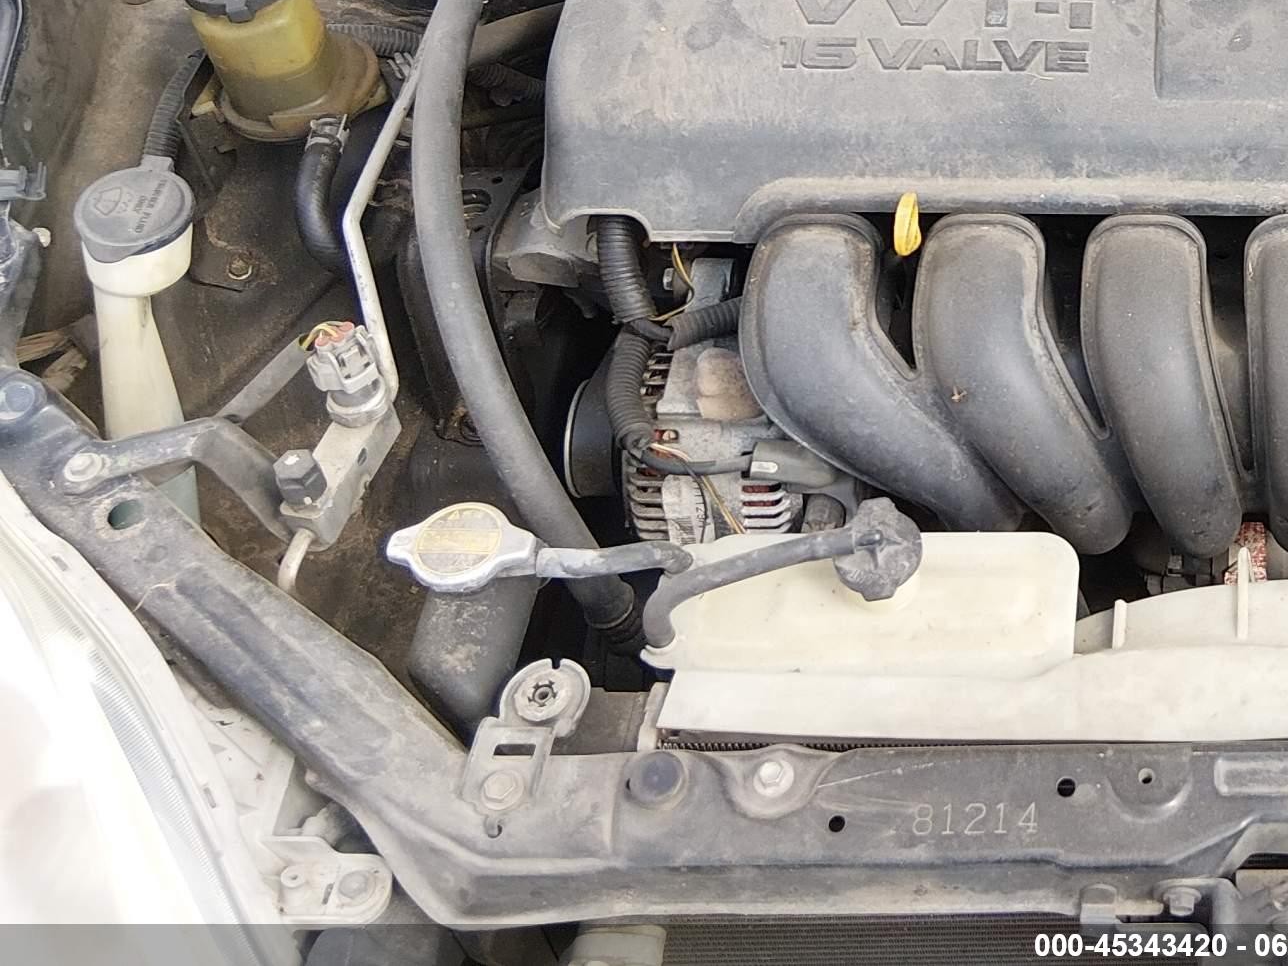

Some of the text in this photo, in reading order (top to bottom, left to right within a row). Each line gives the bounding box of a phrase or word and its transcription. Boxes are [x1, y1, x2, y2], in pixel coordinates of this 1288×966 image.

[779, 35, 1091, 74] 16 VALVE
[911, 802, 1039, 836] 81214
